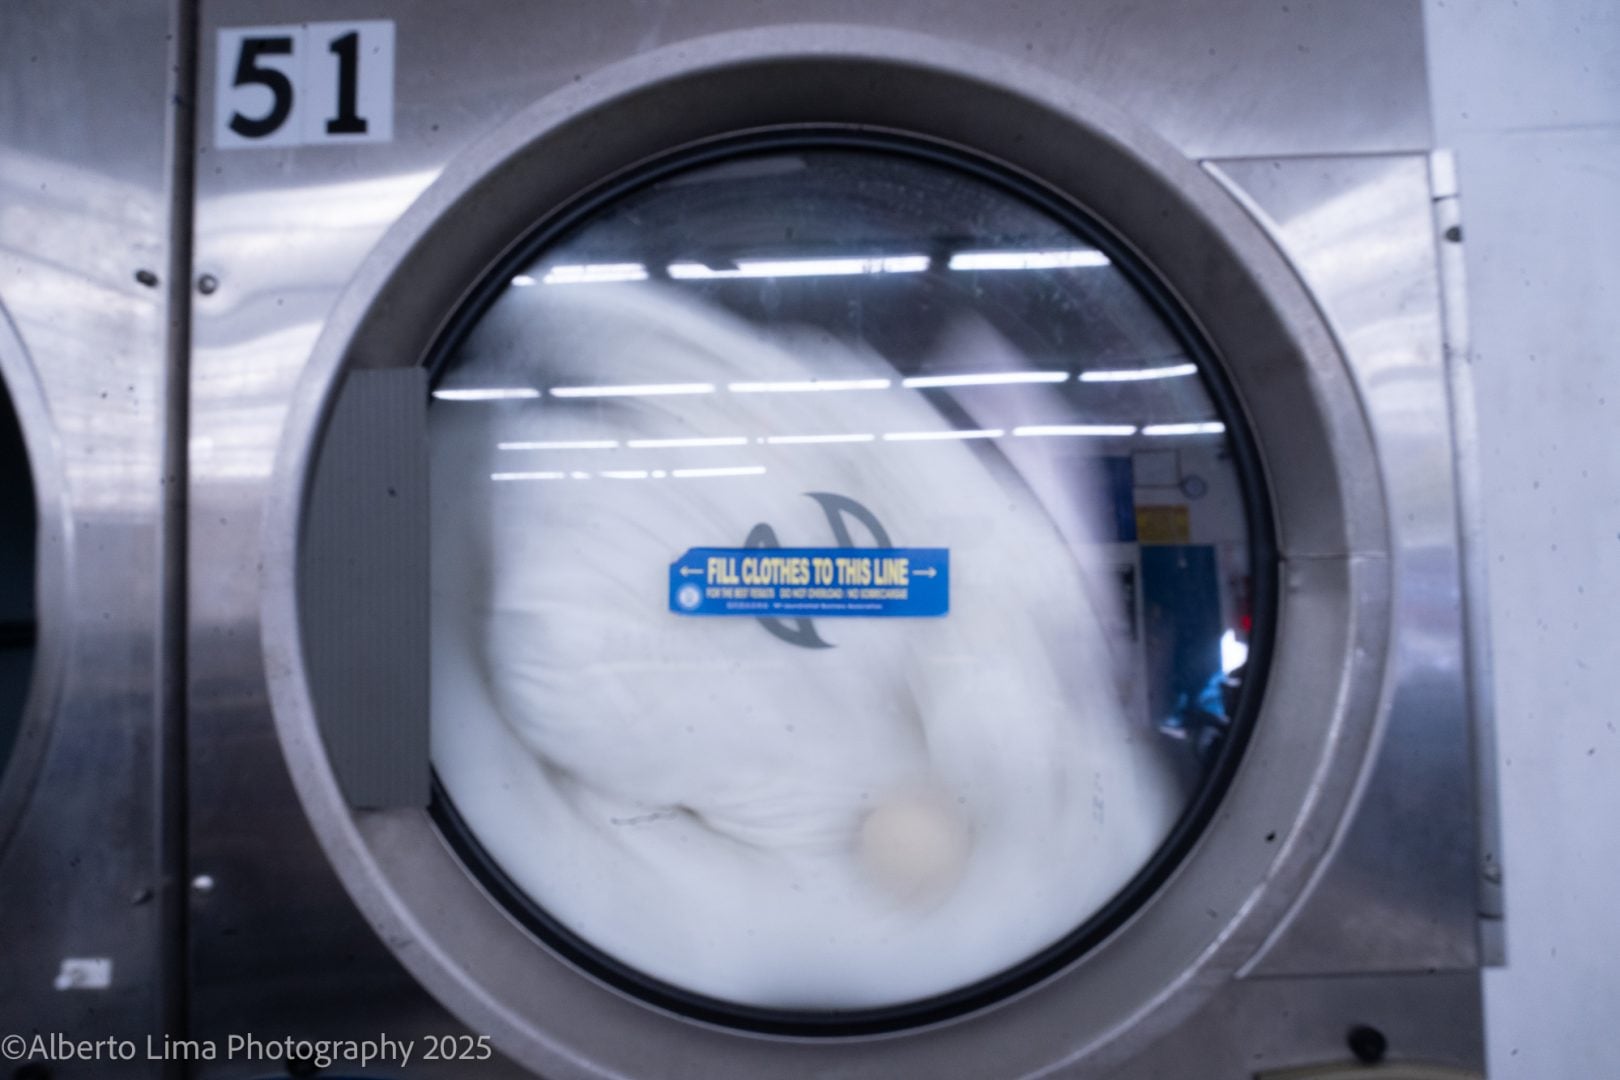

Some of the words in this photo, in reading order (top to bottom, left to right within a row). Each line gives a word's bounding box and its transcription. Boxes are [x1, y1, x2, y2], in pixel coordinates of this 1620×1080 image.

[228, 31, 368, 138] 51
[707, 557, 740, 585] FILL
[742, 557, 810, 585] CLOTHES
[812, 557, 834, 585] TO
[835, 557, 871, 586] THIS
[873, 558, 910, 586] LINE
